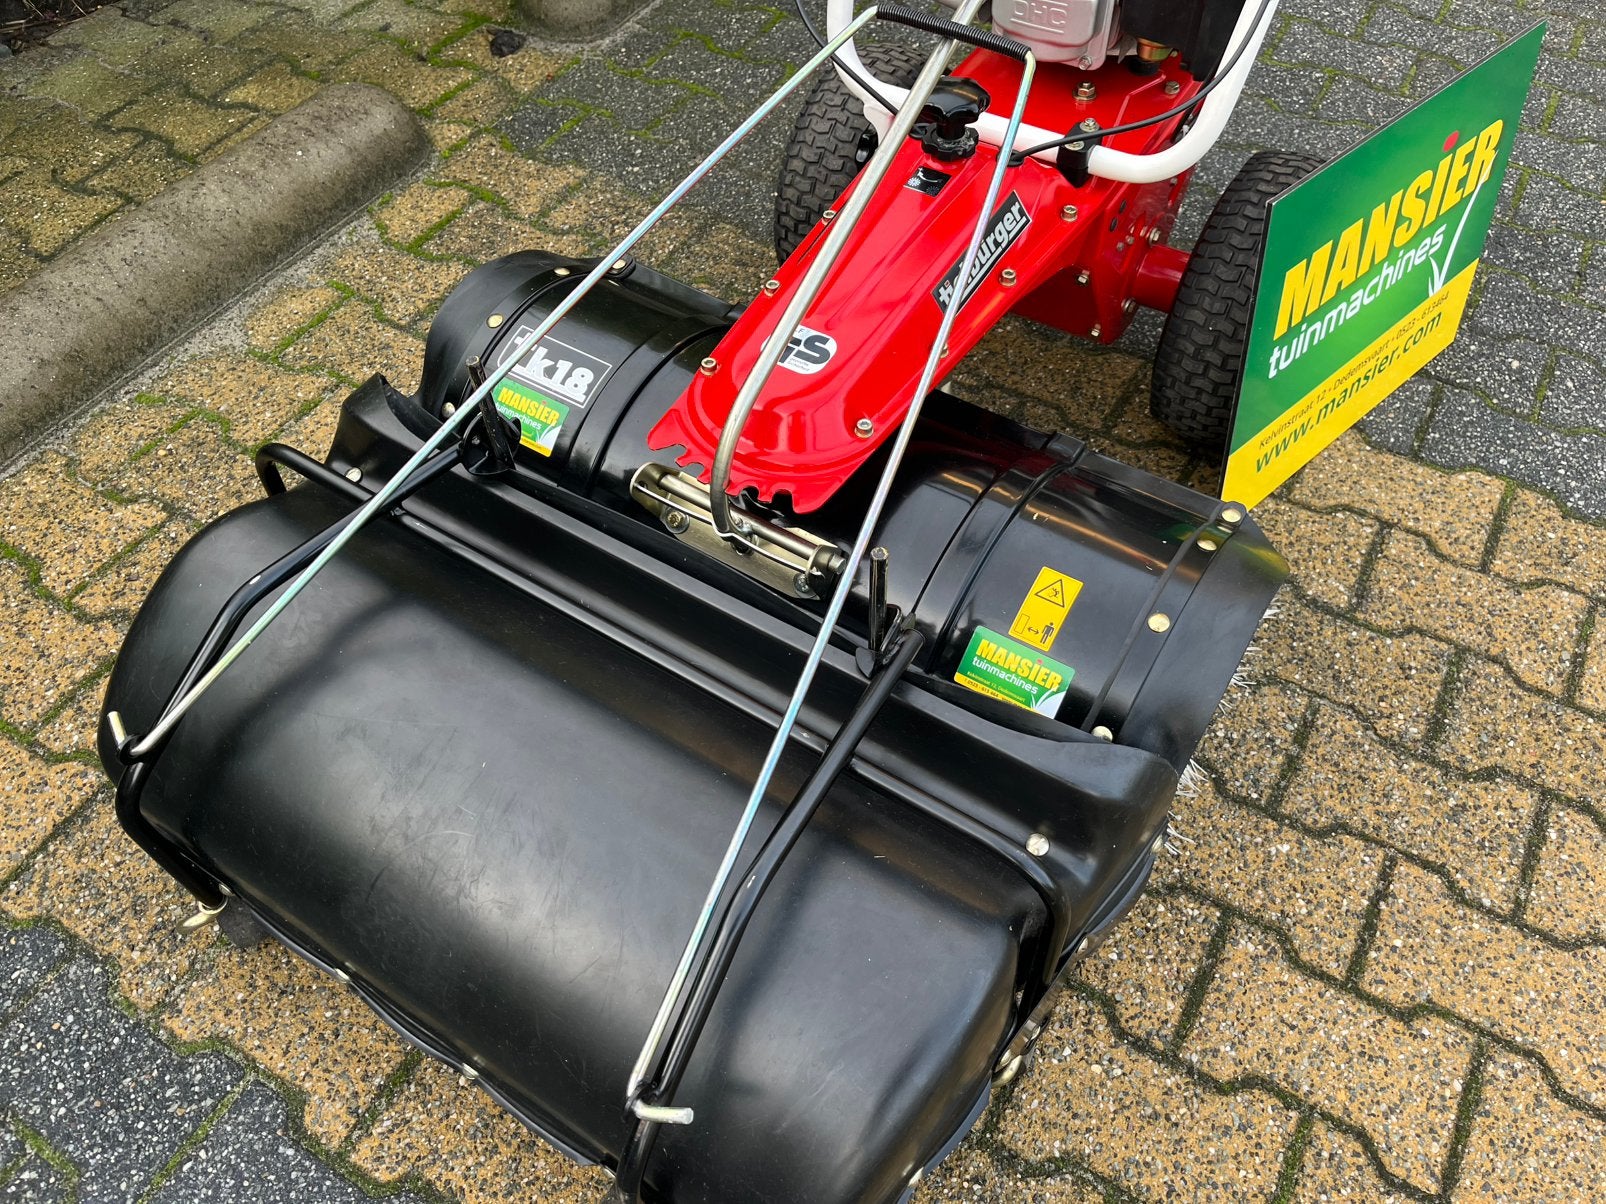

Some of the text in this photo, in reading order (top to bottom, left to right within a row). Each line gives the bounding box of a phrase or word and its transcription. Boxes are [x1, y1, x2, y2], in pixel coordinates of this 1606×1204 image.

[1268, 223, 1447, 379] tuinmachines
[1256, 311, 1443, 473] www.mansier.com
[1259, 401, 1314, 450] Kelvinstraat
[1316, 389, 1327, 405] 12
[1333, 339, 1391, 391] Dedemsvaart
[972, 656, 1039, 695] tuinmachines
